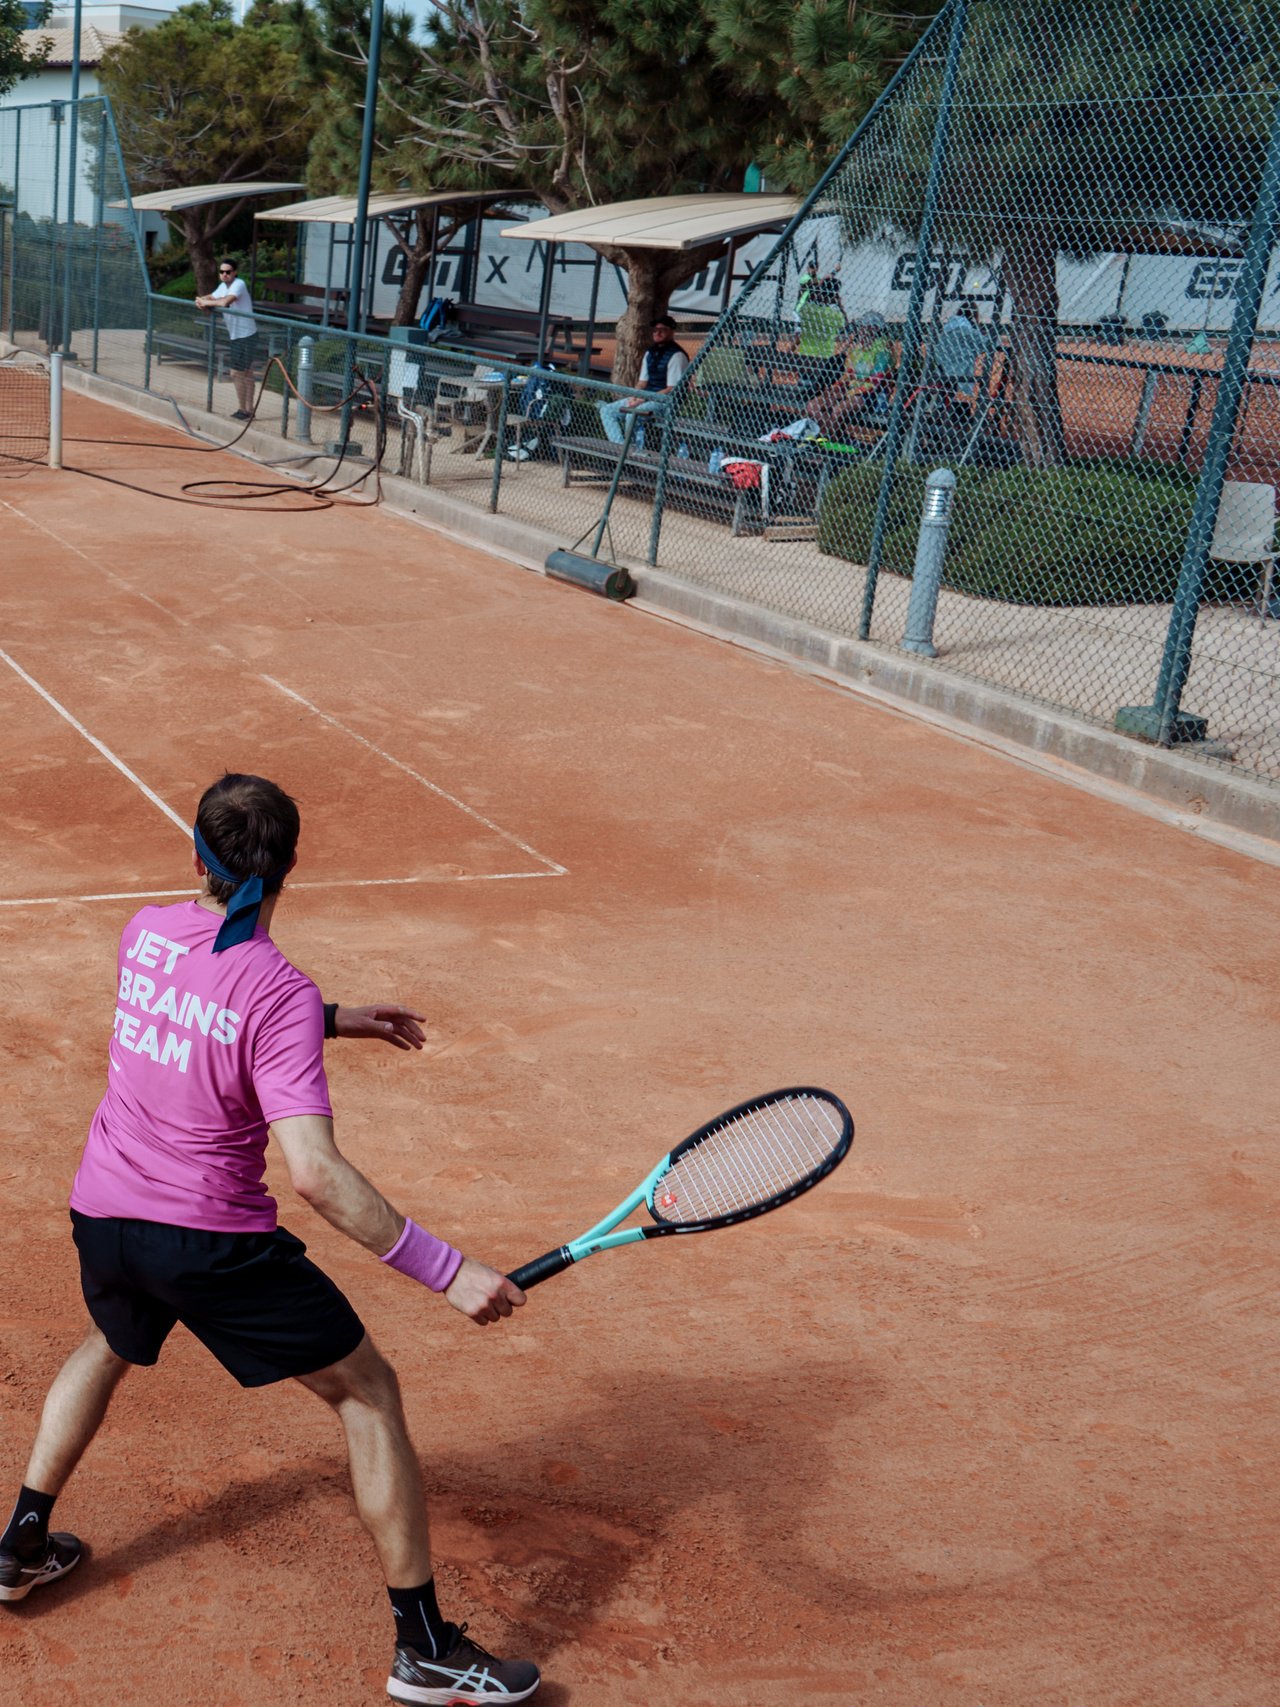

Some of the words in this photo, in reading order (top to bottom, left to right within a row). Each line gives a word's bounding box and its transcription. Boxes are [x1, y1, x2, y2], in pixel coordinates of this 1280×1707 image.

[126, 929, 190, 975] JET
[118, 966, 242, 1045] BRAINS
[114, 1007, 192, 1073] TEAM
